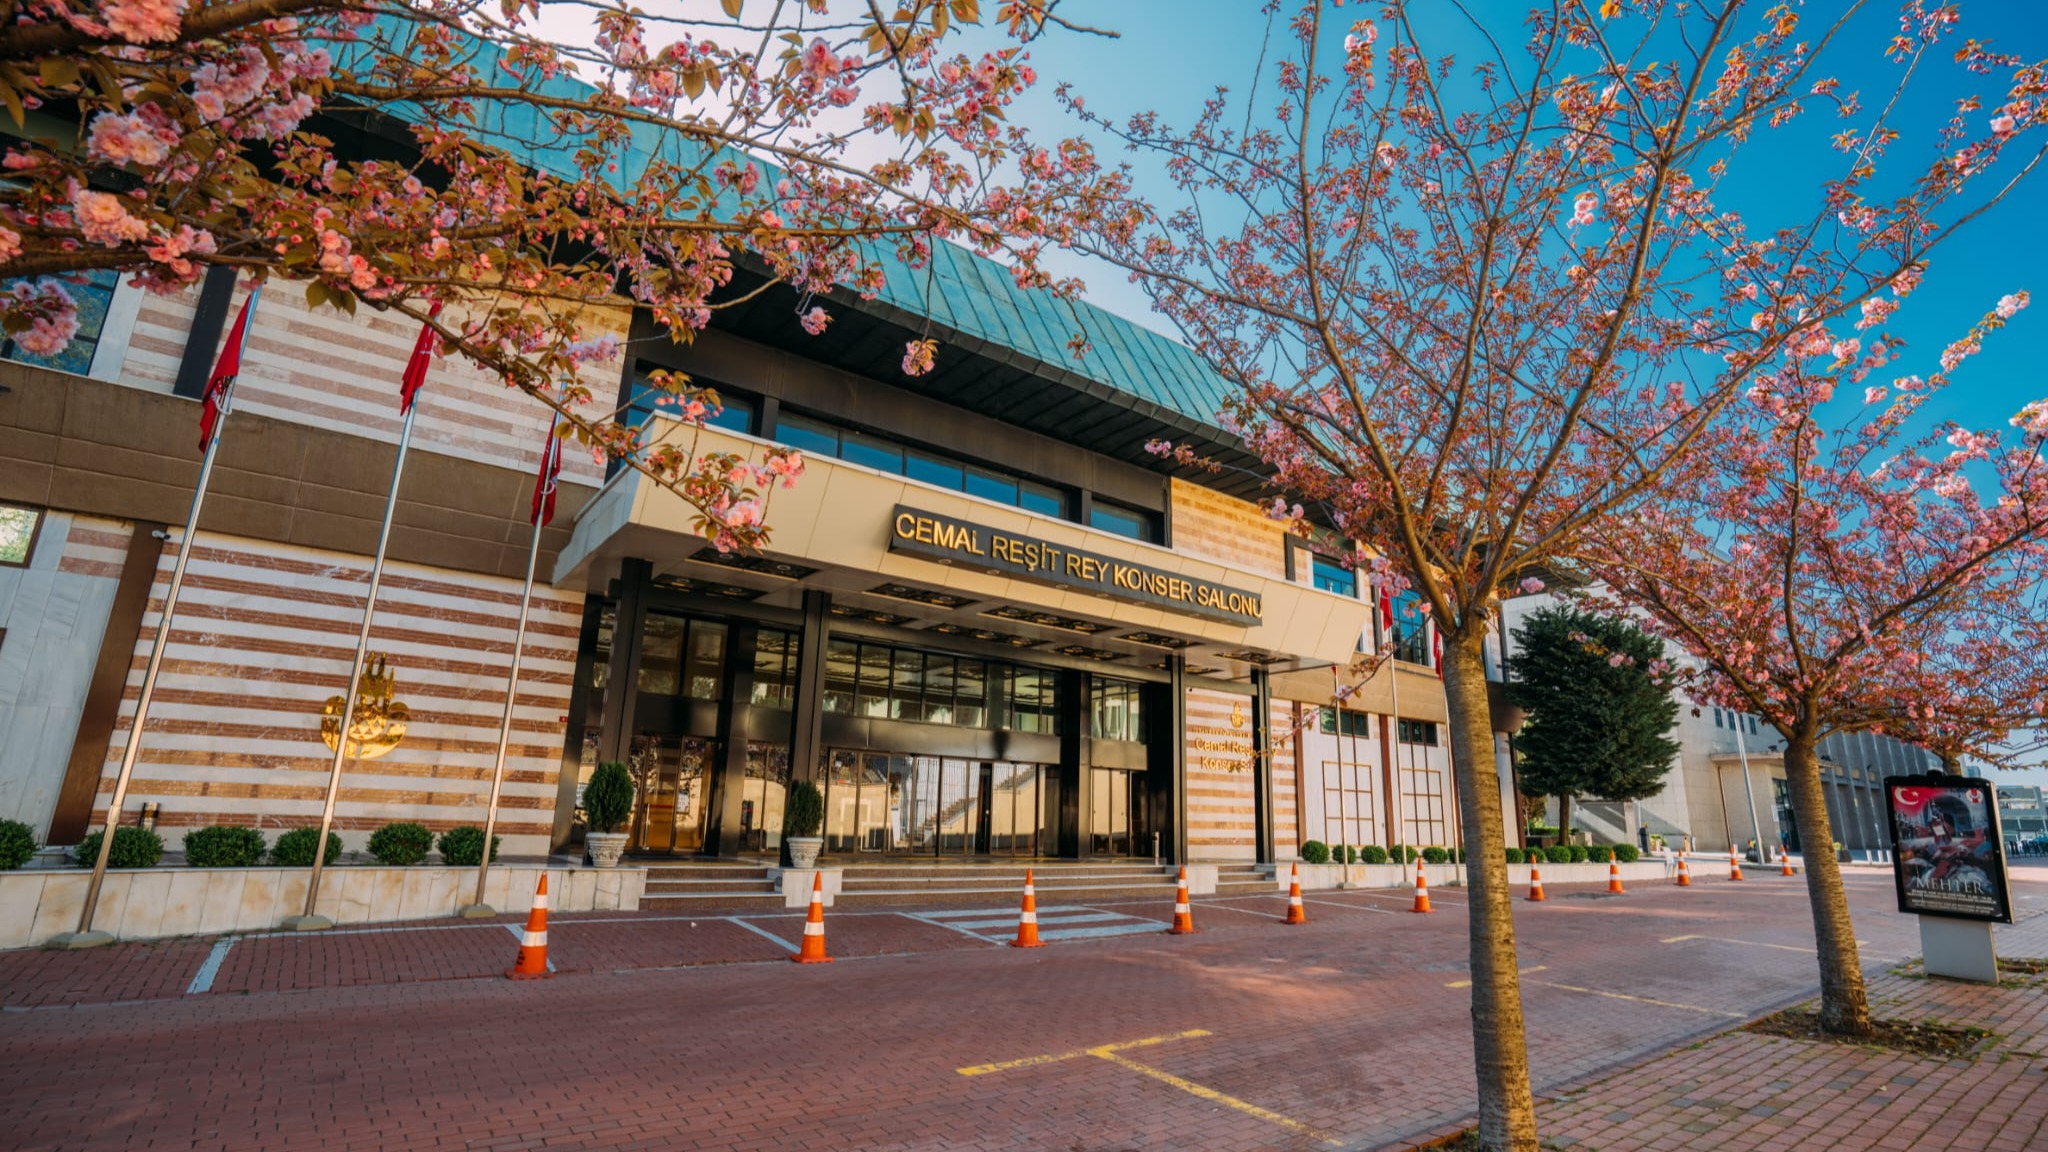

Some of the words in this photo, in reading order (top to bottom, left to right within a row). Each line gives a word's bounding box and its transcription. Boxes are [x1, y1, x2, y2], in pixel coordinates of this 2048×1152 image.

[895, 513, 985, 556] CEMAL
[991, 535, 1061, 572] REŞİT
[1066, 553, 1108, 583] REY
[1113, 564, 1194, 602] KONSER
[1197, 585, 1262, 618] SALONU
[1195, 736, 1228, 752] Cemal
[1916, 877, 1984, 894] MEHTER
